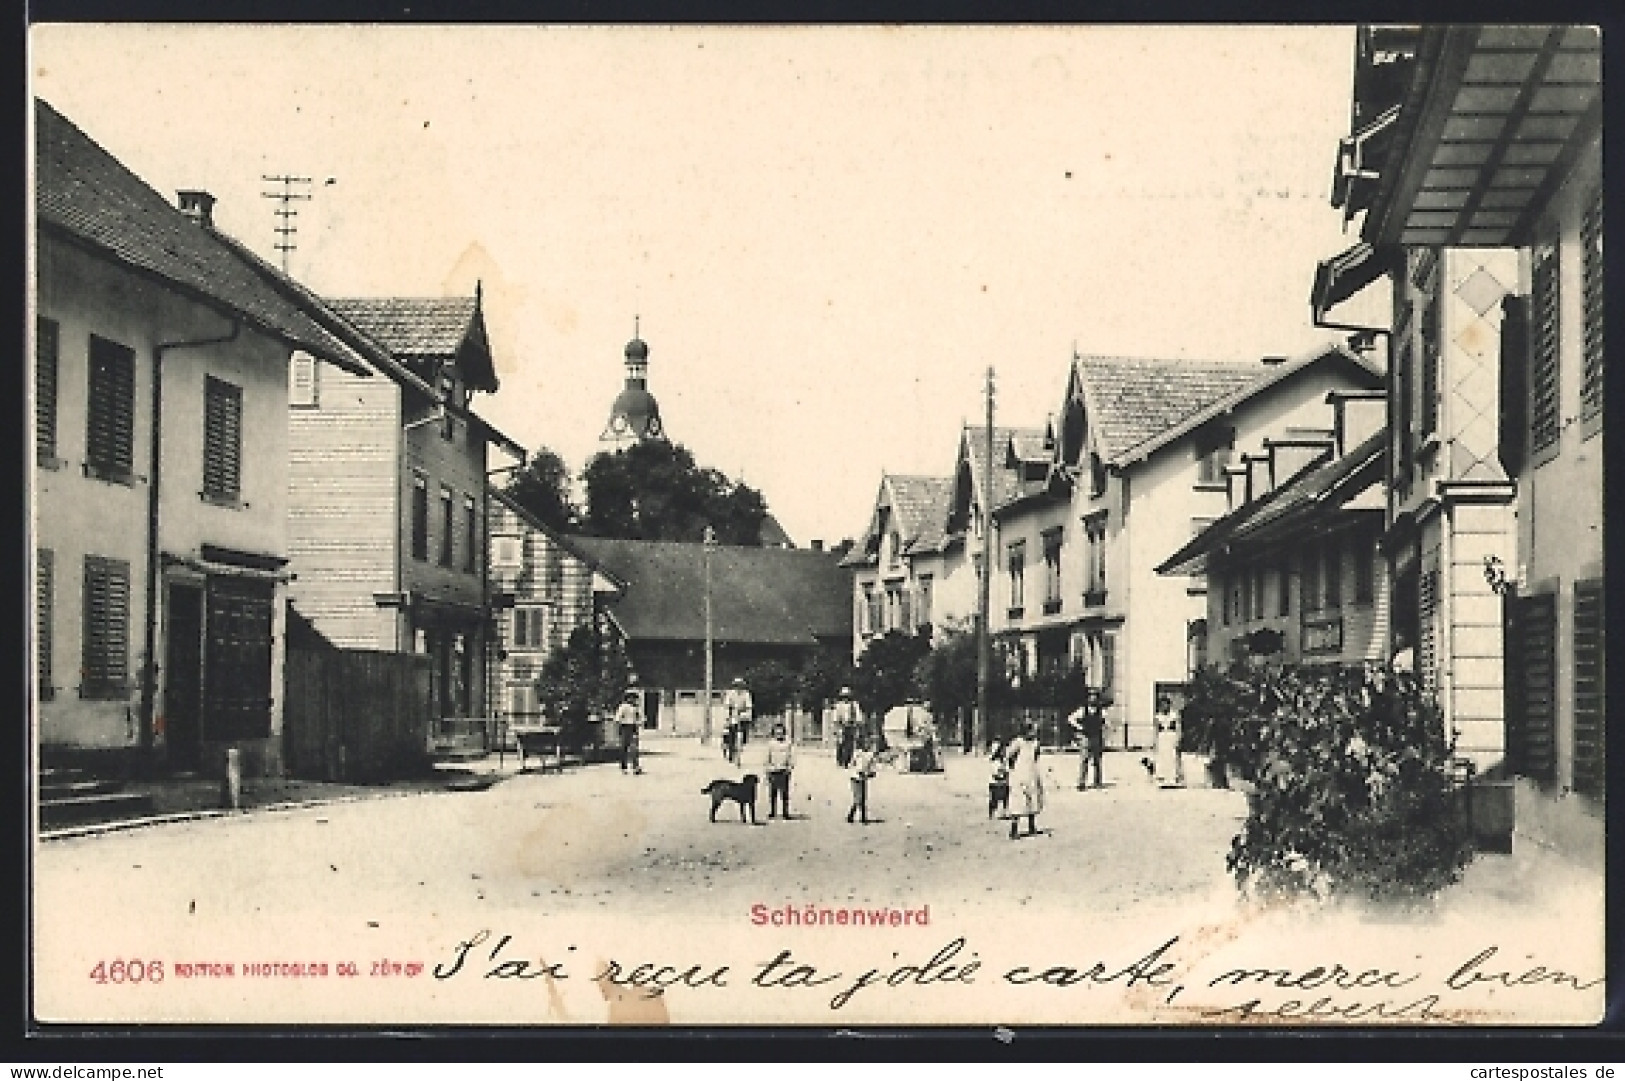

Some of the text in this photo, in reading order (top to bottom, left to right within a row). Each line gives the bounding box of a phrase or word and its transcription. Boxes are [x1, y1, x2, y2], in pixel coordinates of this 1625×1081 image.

[751, 904, 931, 926] Schönenwerd
[89, 957, 165, 985] 4606
[751, 948, 843, 987] ta
[830, 936, 982, 1010] jolie
[1207, 963, 1424, 990] merci
[1446, 944, 1606, 990] bien
